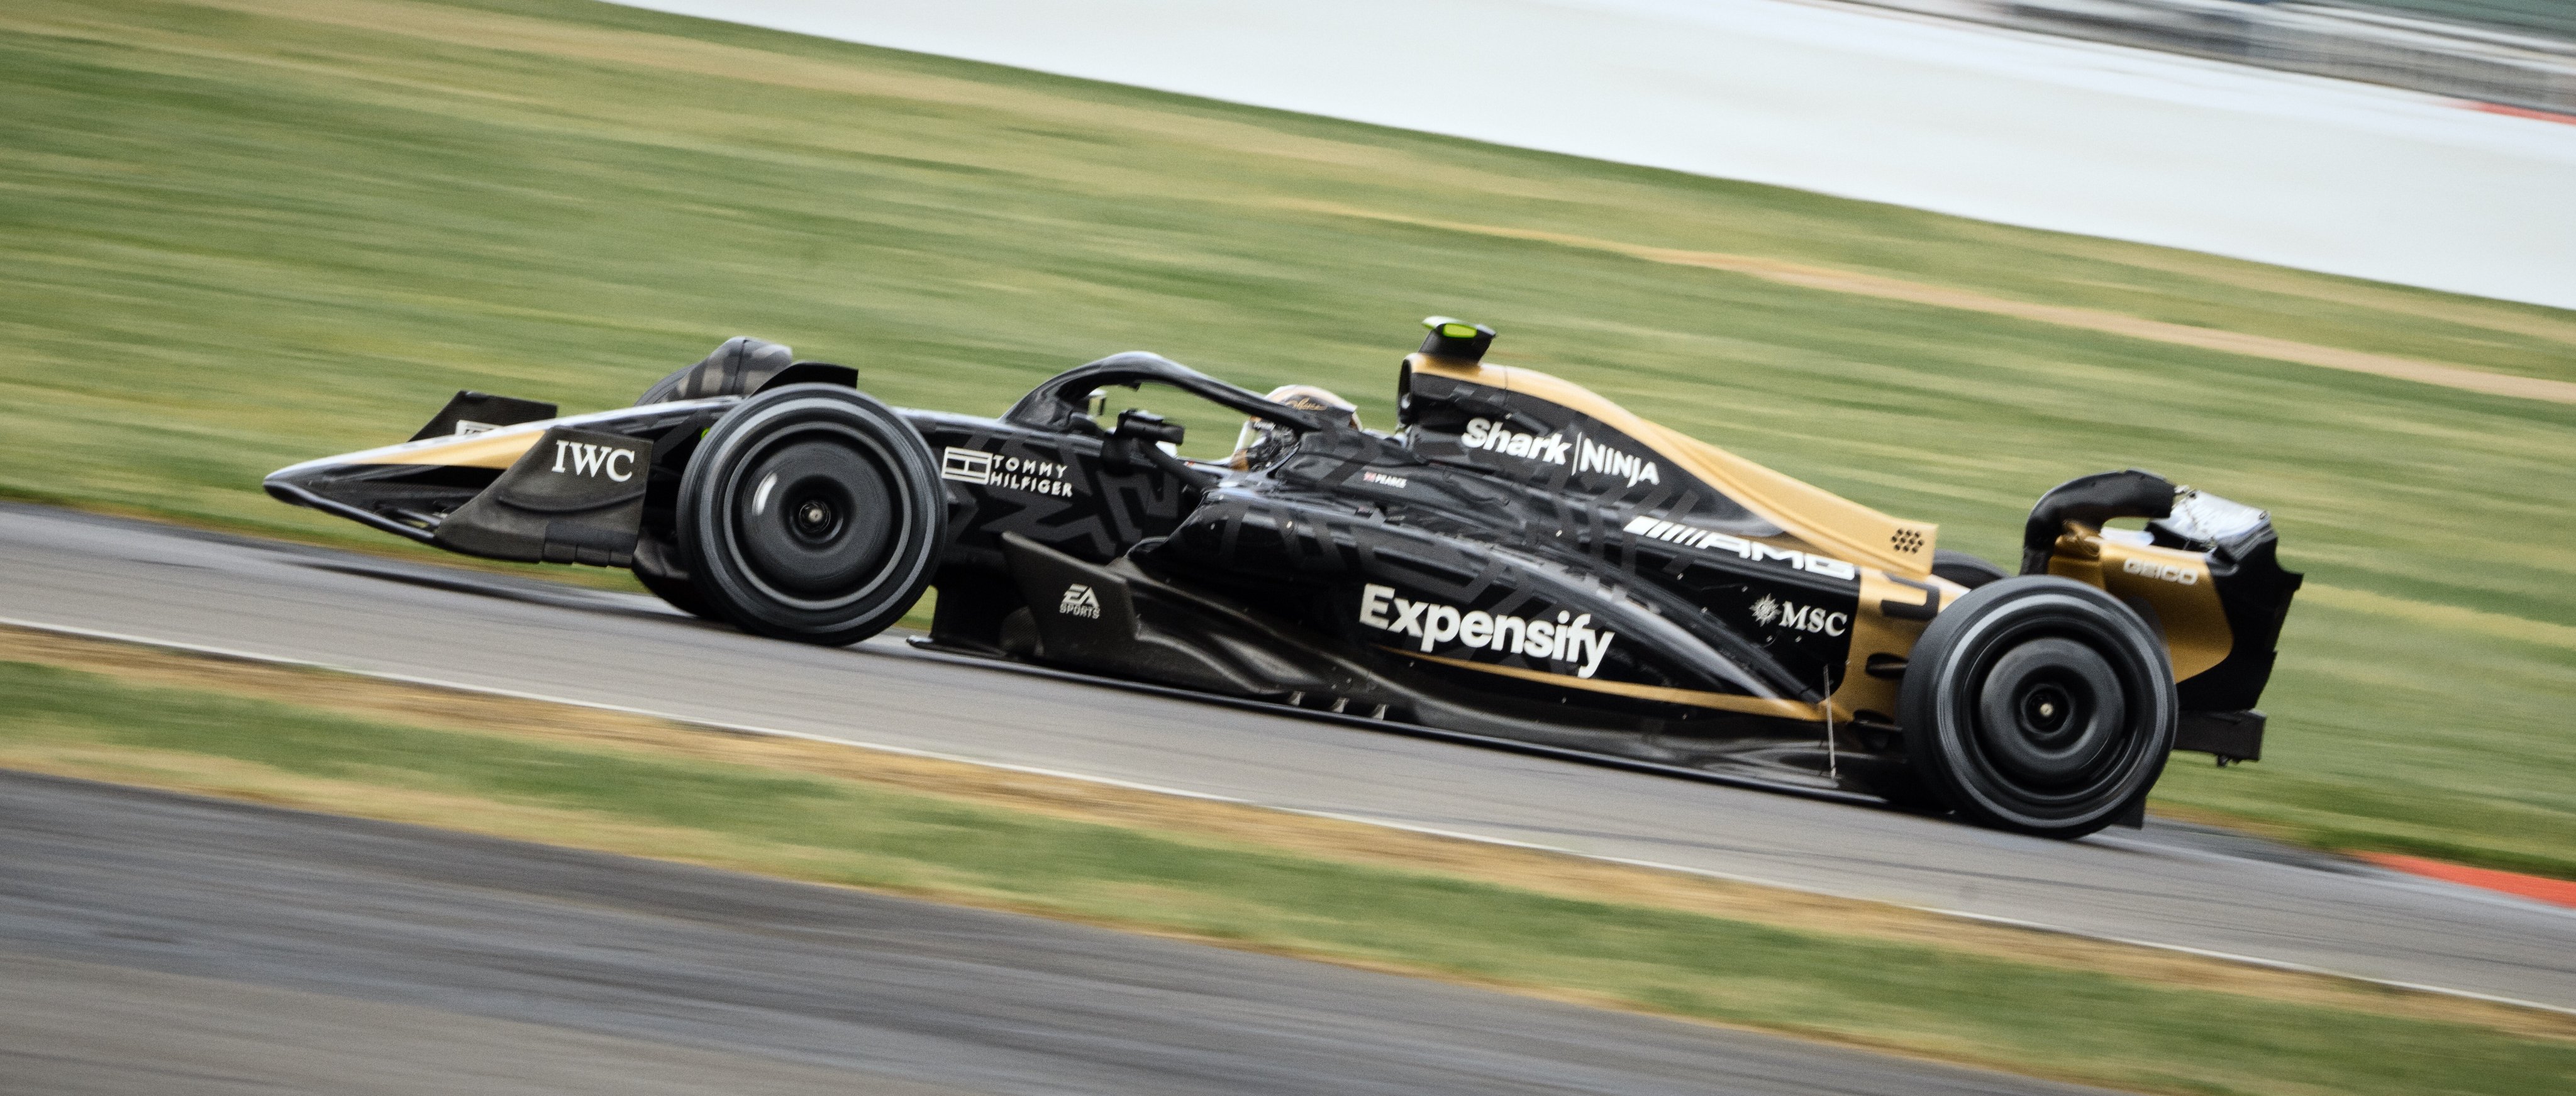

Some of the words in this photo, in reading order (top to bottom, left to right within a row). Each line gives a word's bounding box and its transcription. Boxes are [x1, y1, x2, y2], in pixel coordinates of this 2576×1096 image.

[552, 440, 635, 482] IWC
[993, 455, 1067, 478] TOMMY
[1461, 417, 1572, 465] Shark
[1579, 438, 1660, 488] NINJA
[990, 472, 1073, 497] HILFIGER
[1696, 531, 1855, 580] AMG
[2123, 558, 2199, 585] GEICO
[1059, 603, 1100, 619] SPORTS
[1062, 584, 1099, 609] EA
[1359, 584, 1614, 679] Expensify
[1779, 601, 1848, 637] MSC
